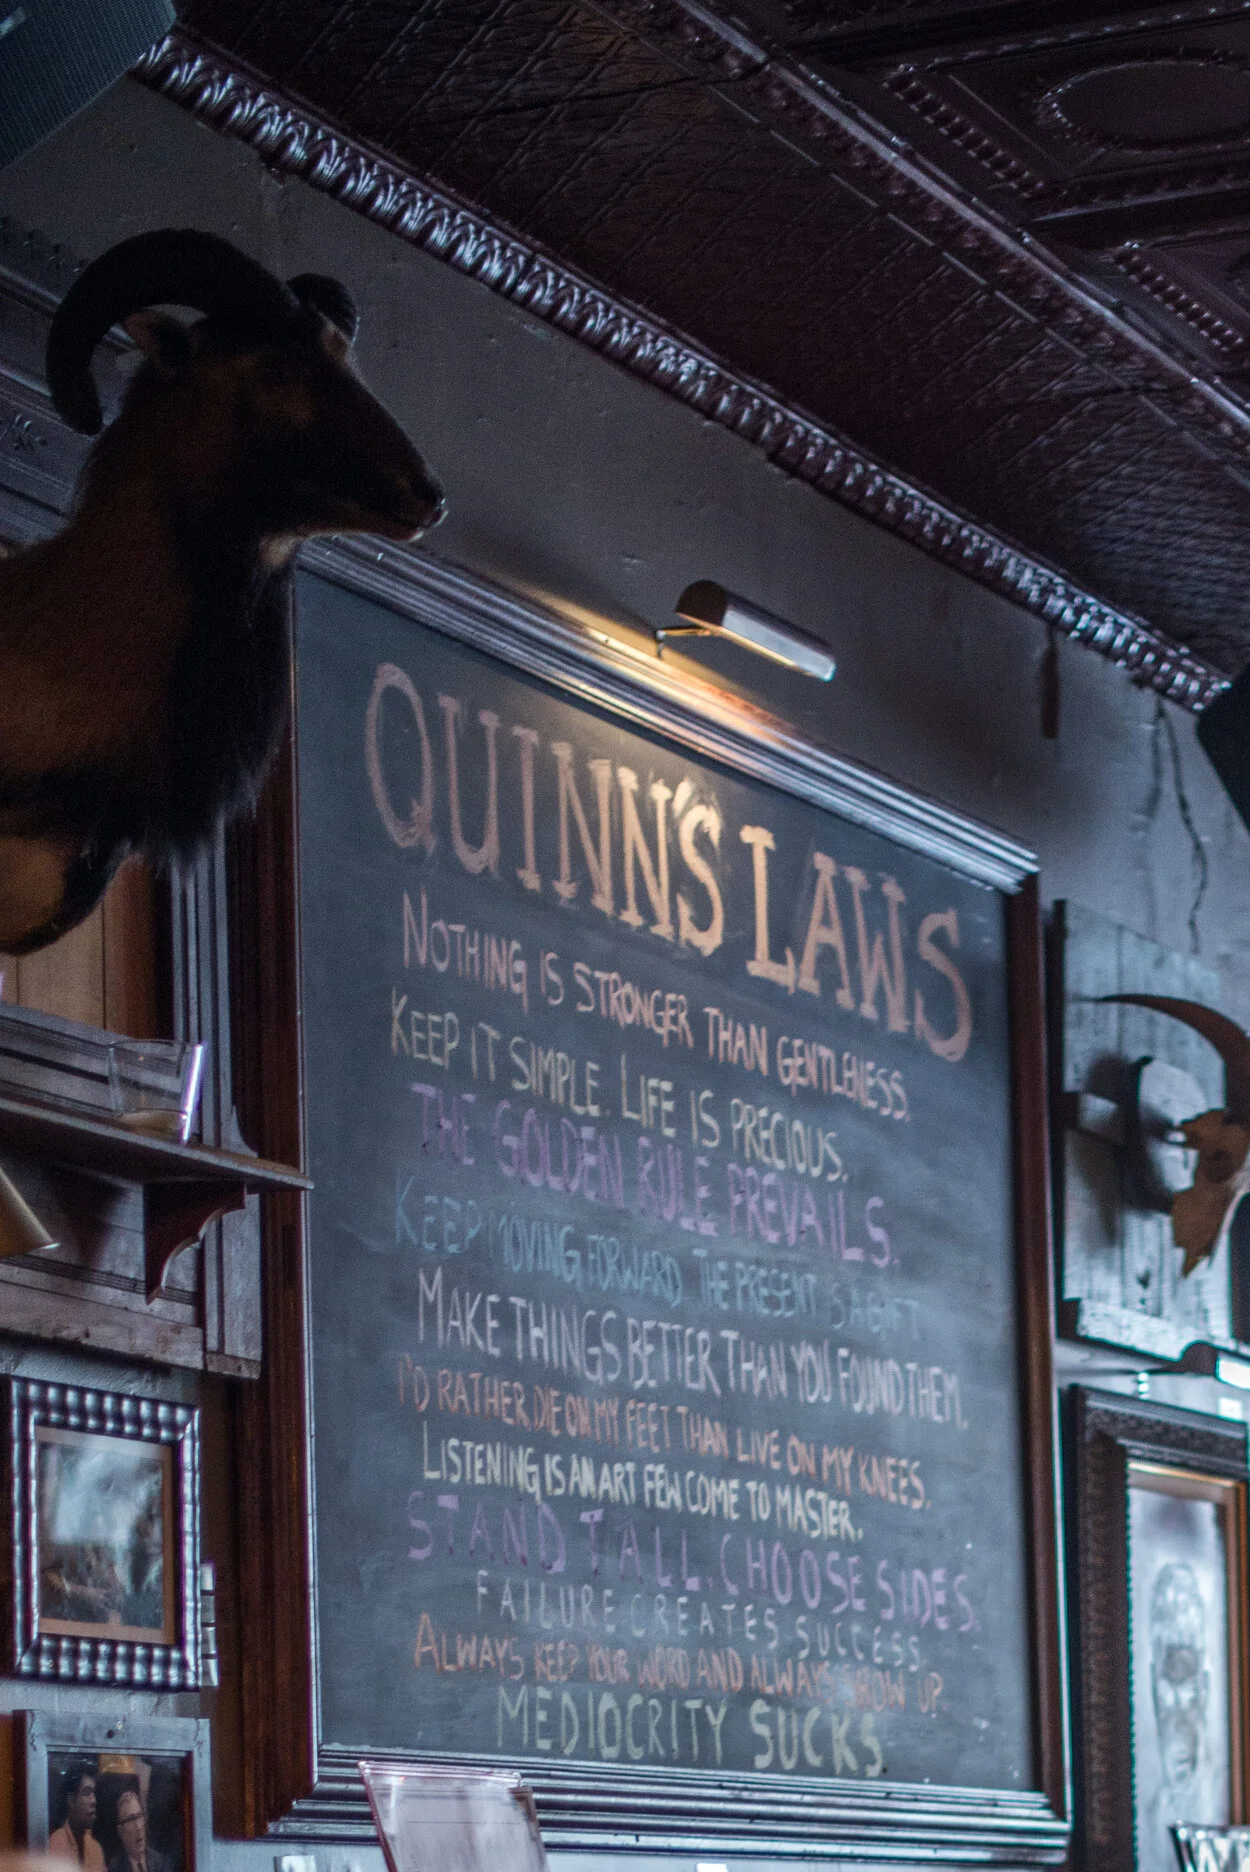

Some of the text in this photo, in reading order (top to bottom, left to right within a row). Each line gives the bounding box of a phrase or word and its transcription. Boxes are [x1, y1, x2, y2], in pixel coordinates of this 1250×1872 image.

[363, 662, 974, 1062] QUINN'S LAWS
[404, 888, 528, 1015] NOTHING
[539, 950, 565, 1005] IS
[573, 961, 694, 1048] STRONGER
[704, 1007, 769, 1077] THAN
[391, 988, 460, 1070] KEEP
[471, 1022, 500, 1081] IT
[621, 1054, 676, 1138] LIFE
[690, 1090, 721, 1147] IS
[731, 1097, 848, 1183] PRECIOUS.
[395, 1175, 481, 1253] KEEP
[587, 1234, 683, 1308] FORWARD
[692, 1248, 729, 1311] THE
[734, 1261, 816, 1318] PRESENT
[409, 1082, 899, 1268] THE GOLDEN RULE PREVAILS.
[418, 1266, 968, 1430] MAKE THINGS BETTER THAN YOU FOUND THEM.
[398, 1352, 933, 1510] I'D RATHER DIE ON MY FEET THAN LIVE ON MY KNEES.
[423, 1420, 864, 1543] LISTENING IS AN ART FEW COME TO MASTER.
[408, 1490, 567, 1574] STAND
[719, 1532, 867, 1615] CHOOSE
[477, 1570, 921, 1672] FAILURE CREATES SUCCESS
[415, 1611, 525, 1681] ALWAYS
[586, 1640, 632, 1684] YOUR
[636, 1643, 692, 1691] WORD
[696, 1647, 744, 1692] AND
[750, 1653, 834, 1704] ALWAYS
[497, 1683, 884, 1778] MEDIOCRITY SUCKS
